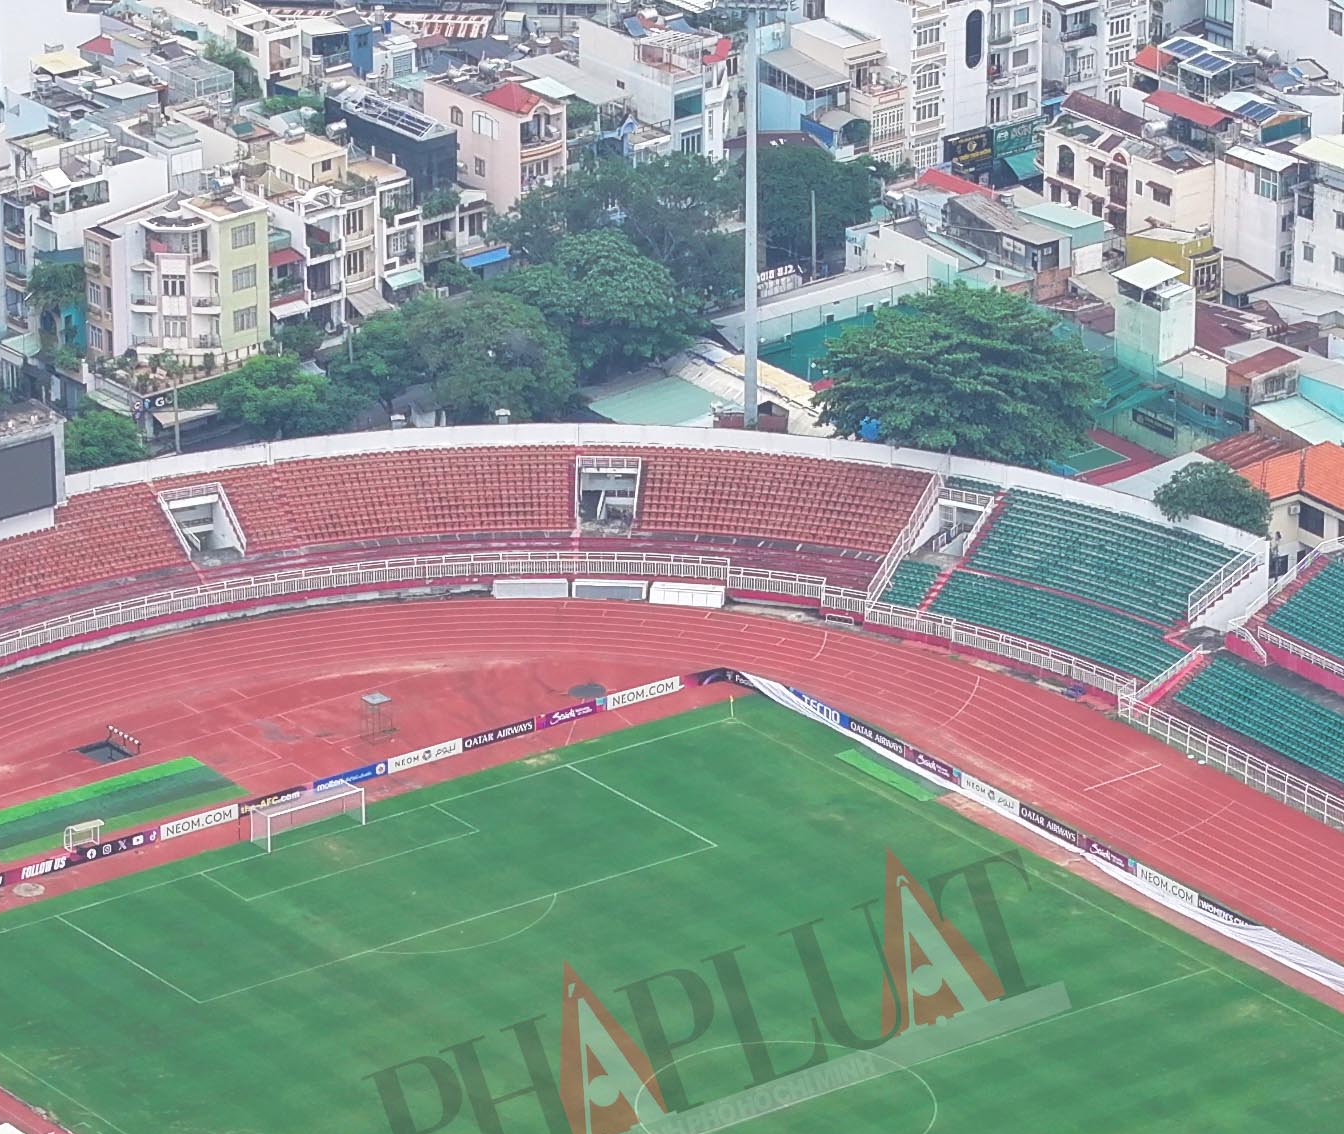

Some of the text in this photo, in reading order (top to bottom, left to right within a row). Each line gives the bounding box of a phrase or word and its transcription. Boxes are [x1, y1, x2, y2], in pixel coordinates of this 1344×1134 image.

[612, 681, 674, 707] NEOM.COM
[464, 720, 532, 749] QATAR AIRWAYS
[850, 721, 903, 754] QATAR AIRWAYS
[395, 755, 419, 768] NEOM
[966, 779, 986, 794] NEOM
[166, 809, 233, 837] NEOM.COM
[1020, 807, 1076, 842] QATAR AIRWAYS
[21, 856, 66, 880] FOLLOW US
[1140, 868, 1194, 904] NEOM.COM
